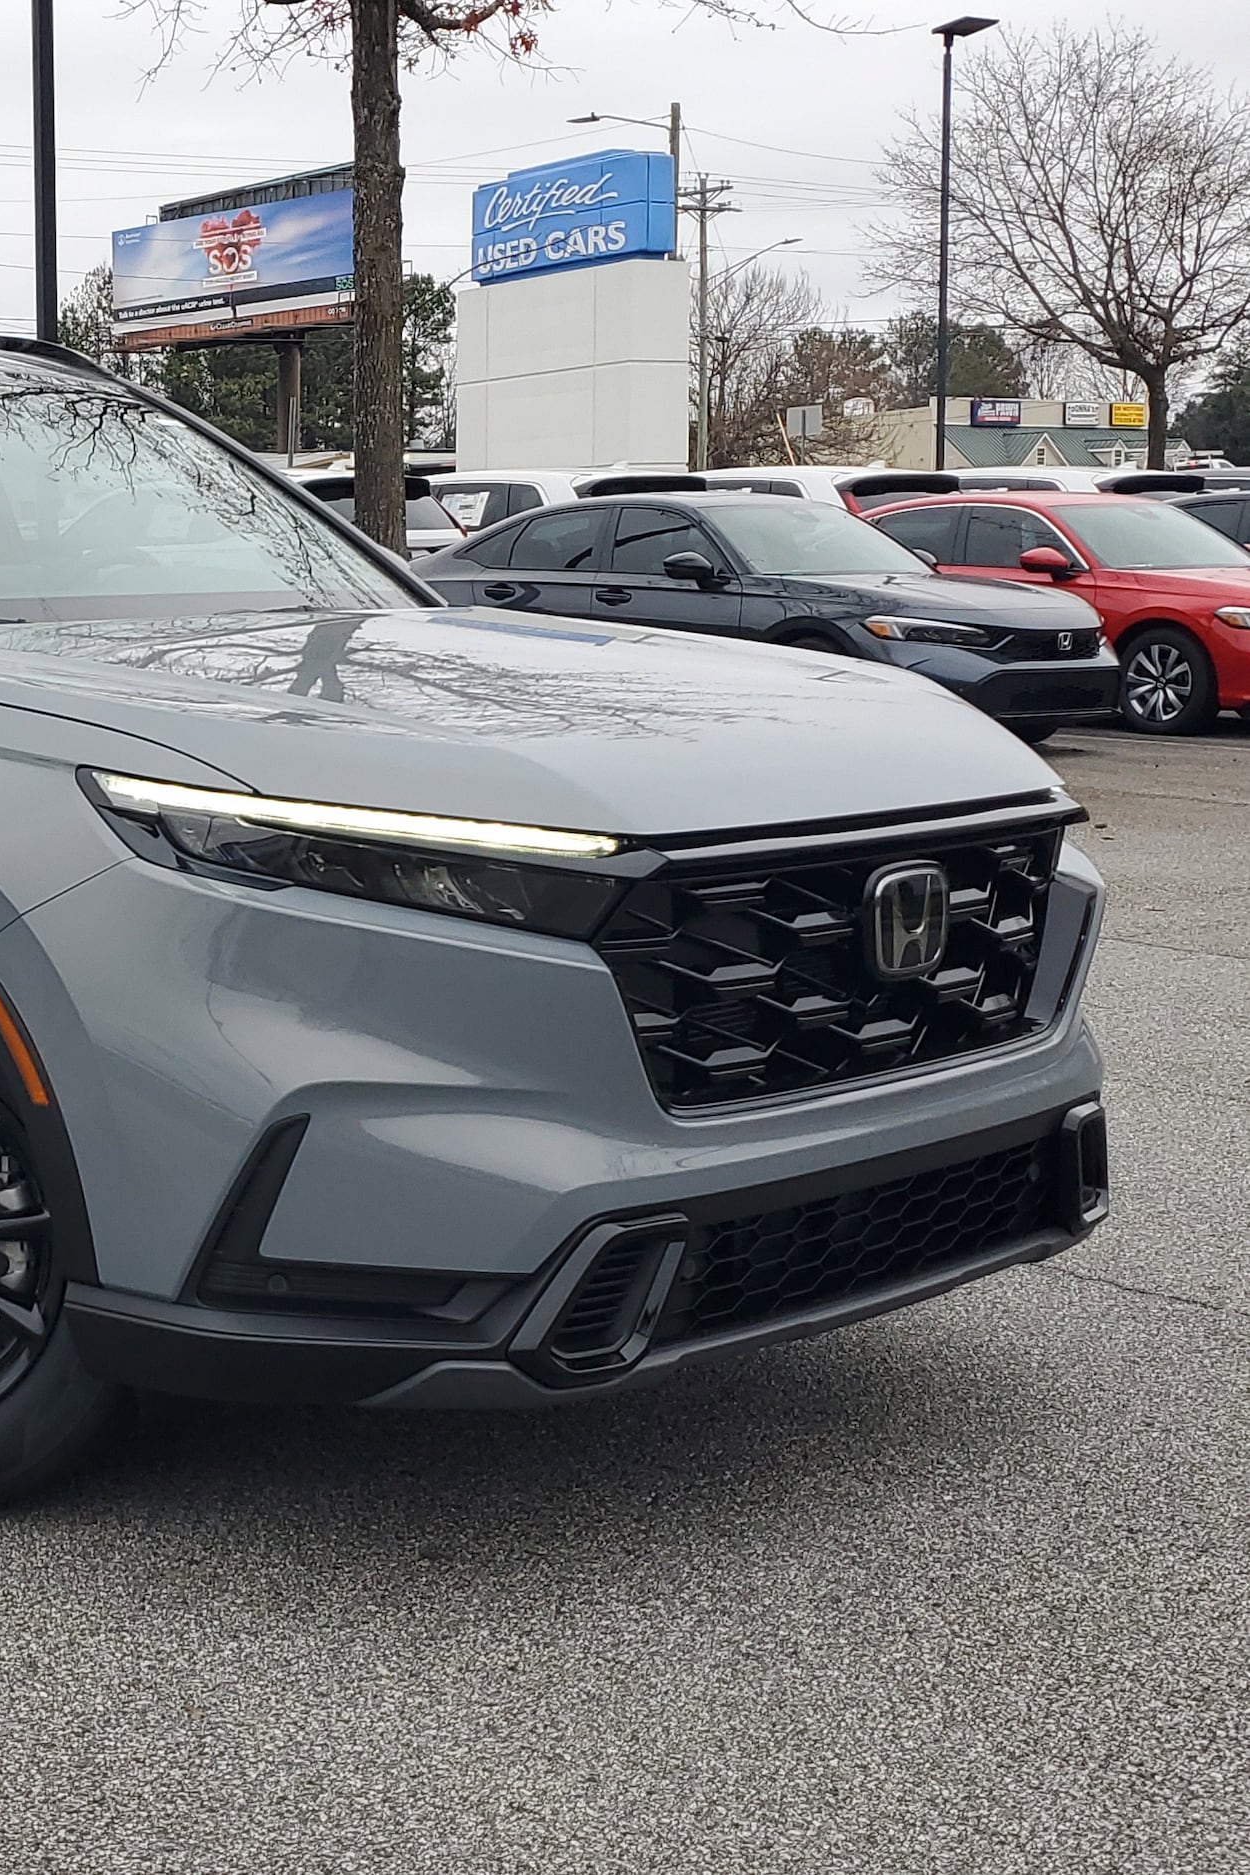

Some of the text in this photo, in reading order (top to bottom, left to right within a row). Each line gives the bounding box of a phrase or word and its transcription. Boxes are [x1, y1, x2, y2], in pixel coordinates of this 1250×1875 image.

[483, 173, 618, 232] Certified
[208, 244, 252, 275] SOS
[477, 221, 626, 275] USED CARS
